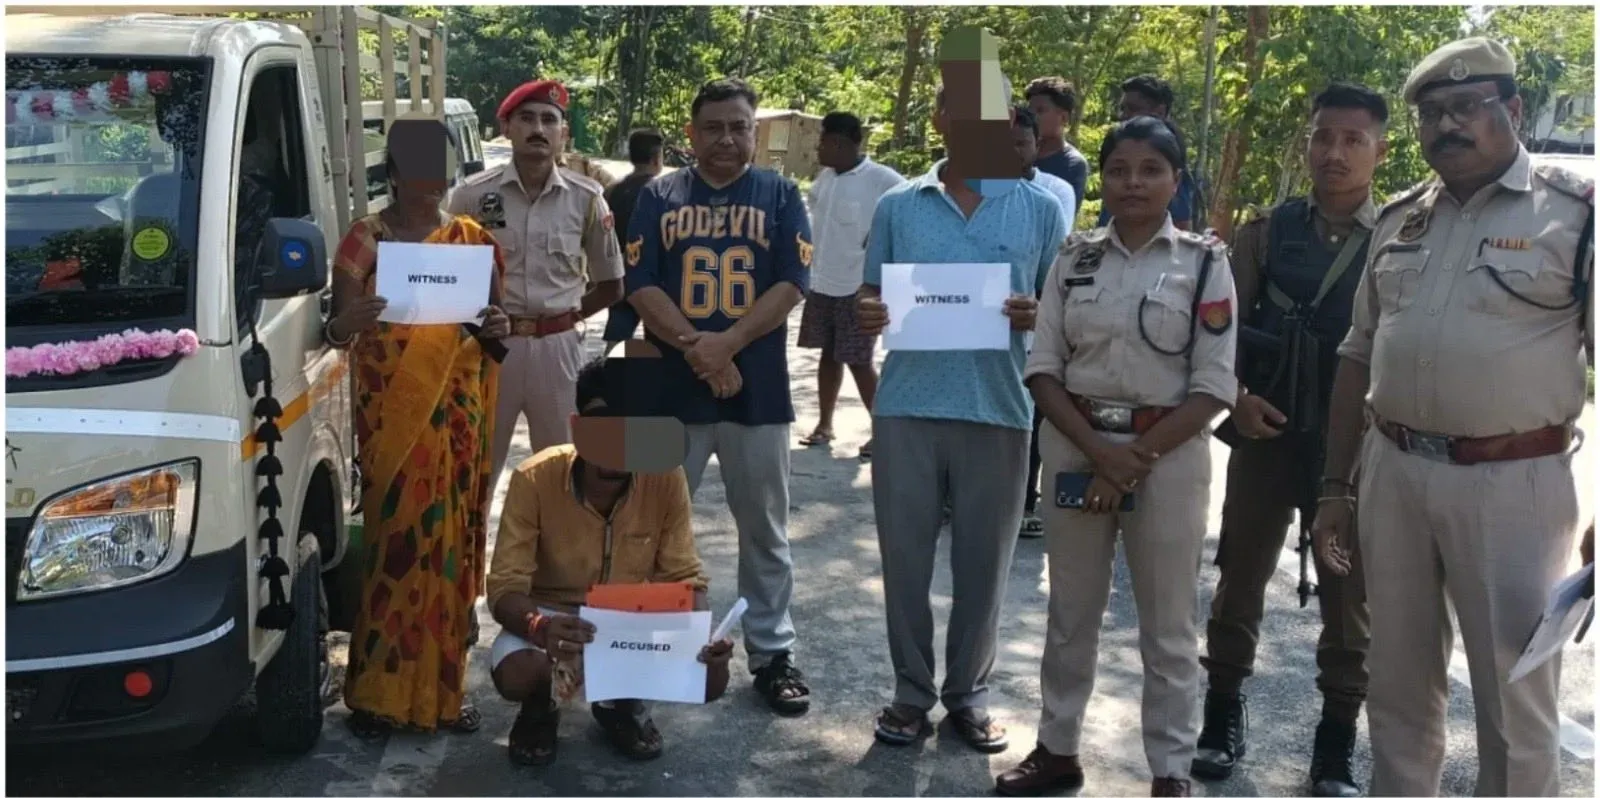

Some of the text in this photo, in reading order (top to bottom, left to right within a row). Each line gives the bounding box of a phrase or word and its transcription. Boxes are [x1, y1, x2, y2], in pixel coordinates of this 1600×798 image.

[660, 204, 770, 251] GODEVIL
[407, 274, 458, 284] WITNESS
[681, 245, 756, 319] 66
[916, 294, 970, 304] WITNESS
[610, 640, 671, 652] ACCUSED
